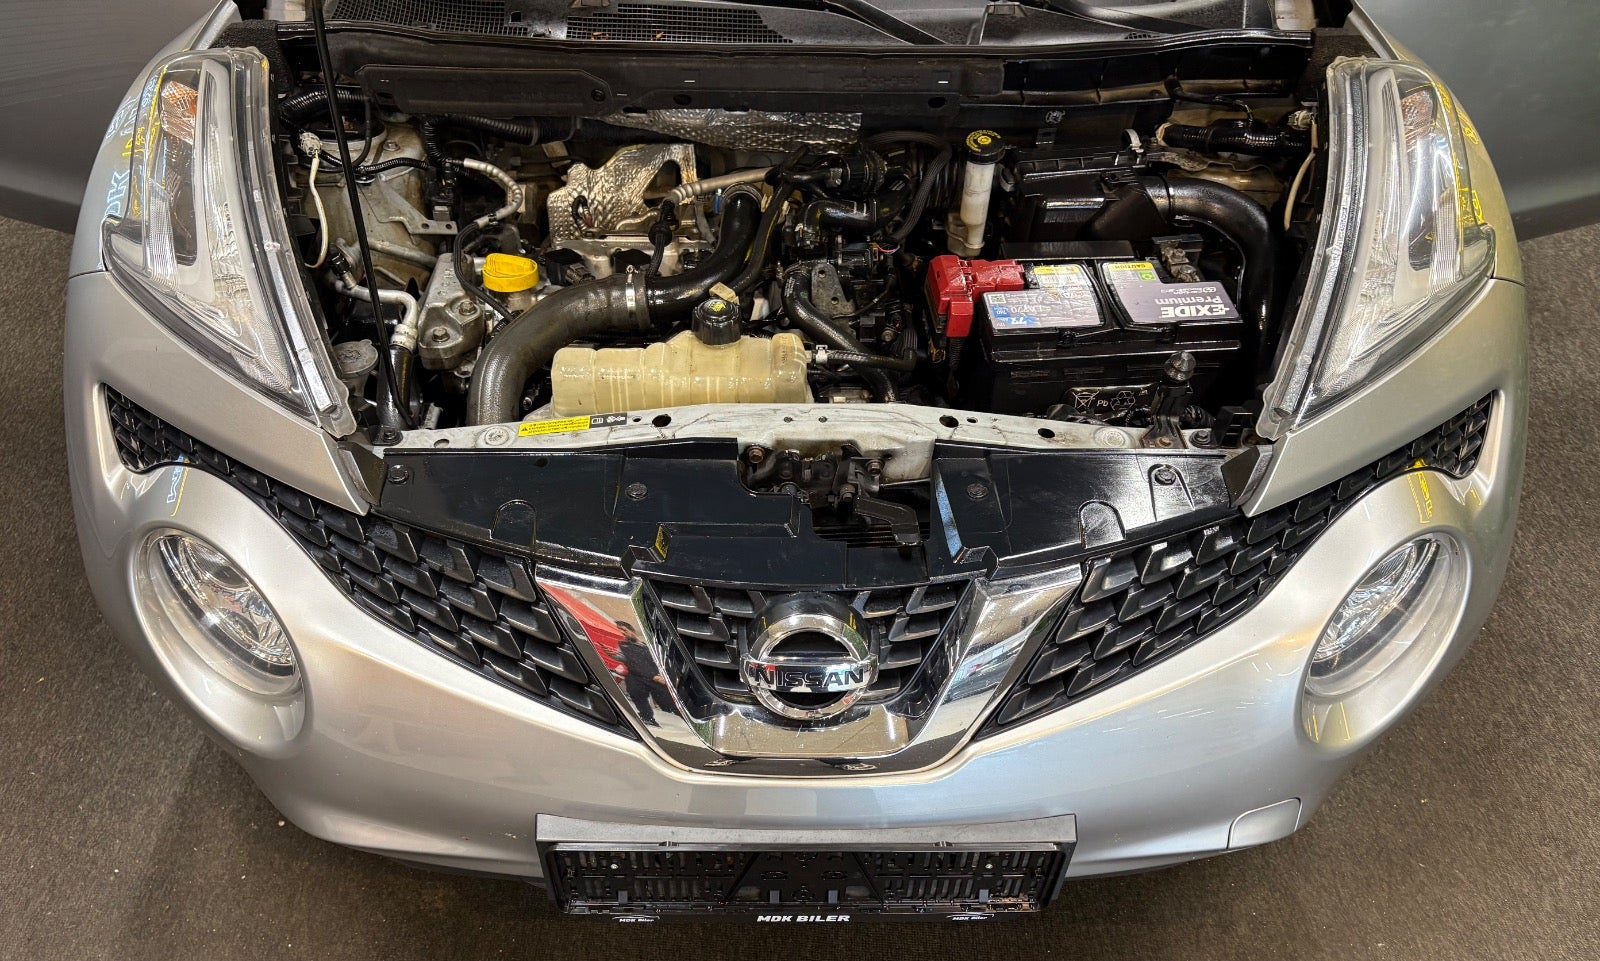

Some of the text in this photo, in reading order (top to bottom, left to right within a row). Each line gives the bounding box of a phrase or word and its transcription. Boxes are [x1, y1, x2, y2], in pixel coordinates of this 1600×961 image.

[1155, 295, 1222, 305] Premium
[1161, 304, 1229, 318] EXIDE
[1096, 399, 1109, 407] Pb
[754, 667, 864, 688] NISSAN
